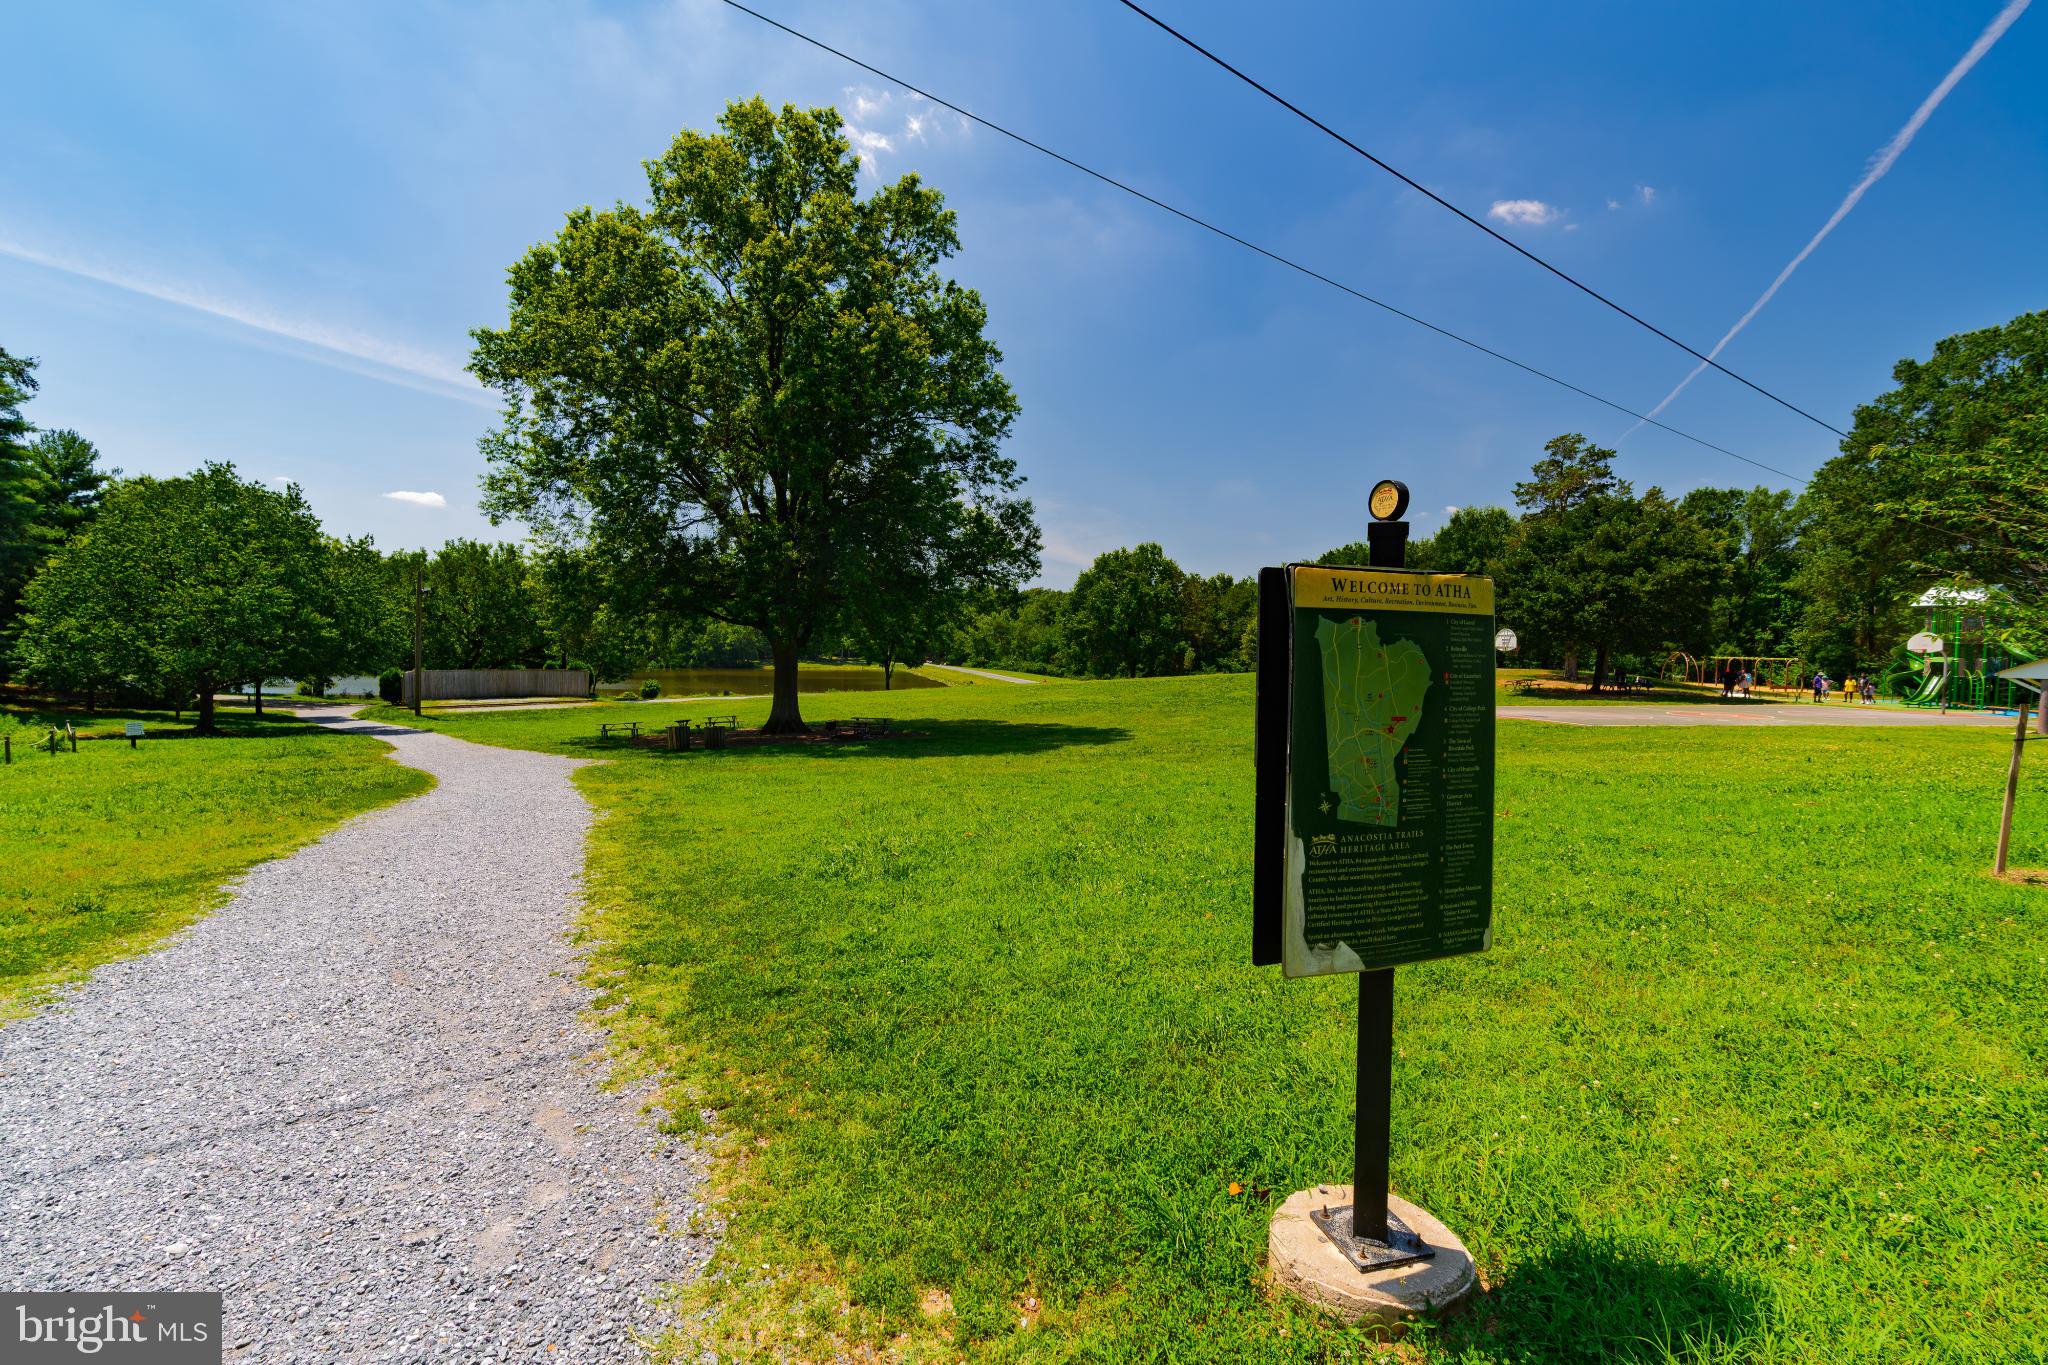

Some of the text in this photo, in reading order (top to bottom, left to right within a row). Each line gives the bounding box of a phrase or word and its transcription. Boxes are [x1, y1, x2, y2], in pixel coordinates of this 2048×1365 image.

[1331, 577, 1471, 599] WELCOME TO ATHA
[1336, 595, 1359, 604] History,
[1360, 596, 1384, 605] Culture,
[1385, 597, 1415, 606] Recreation,
[1341, 830, 1424, 844] ANACOSTIA TRAILS
[1340, 841, 1410, 854] HERITAGE AREA
